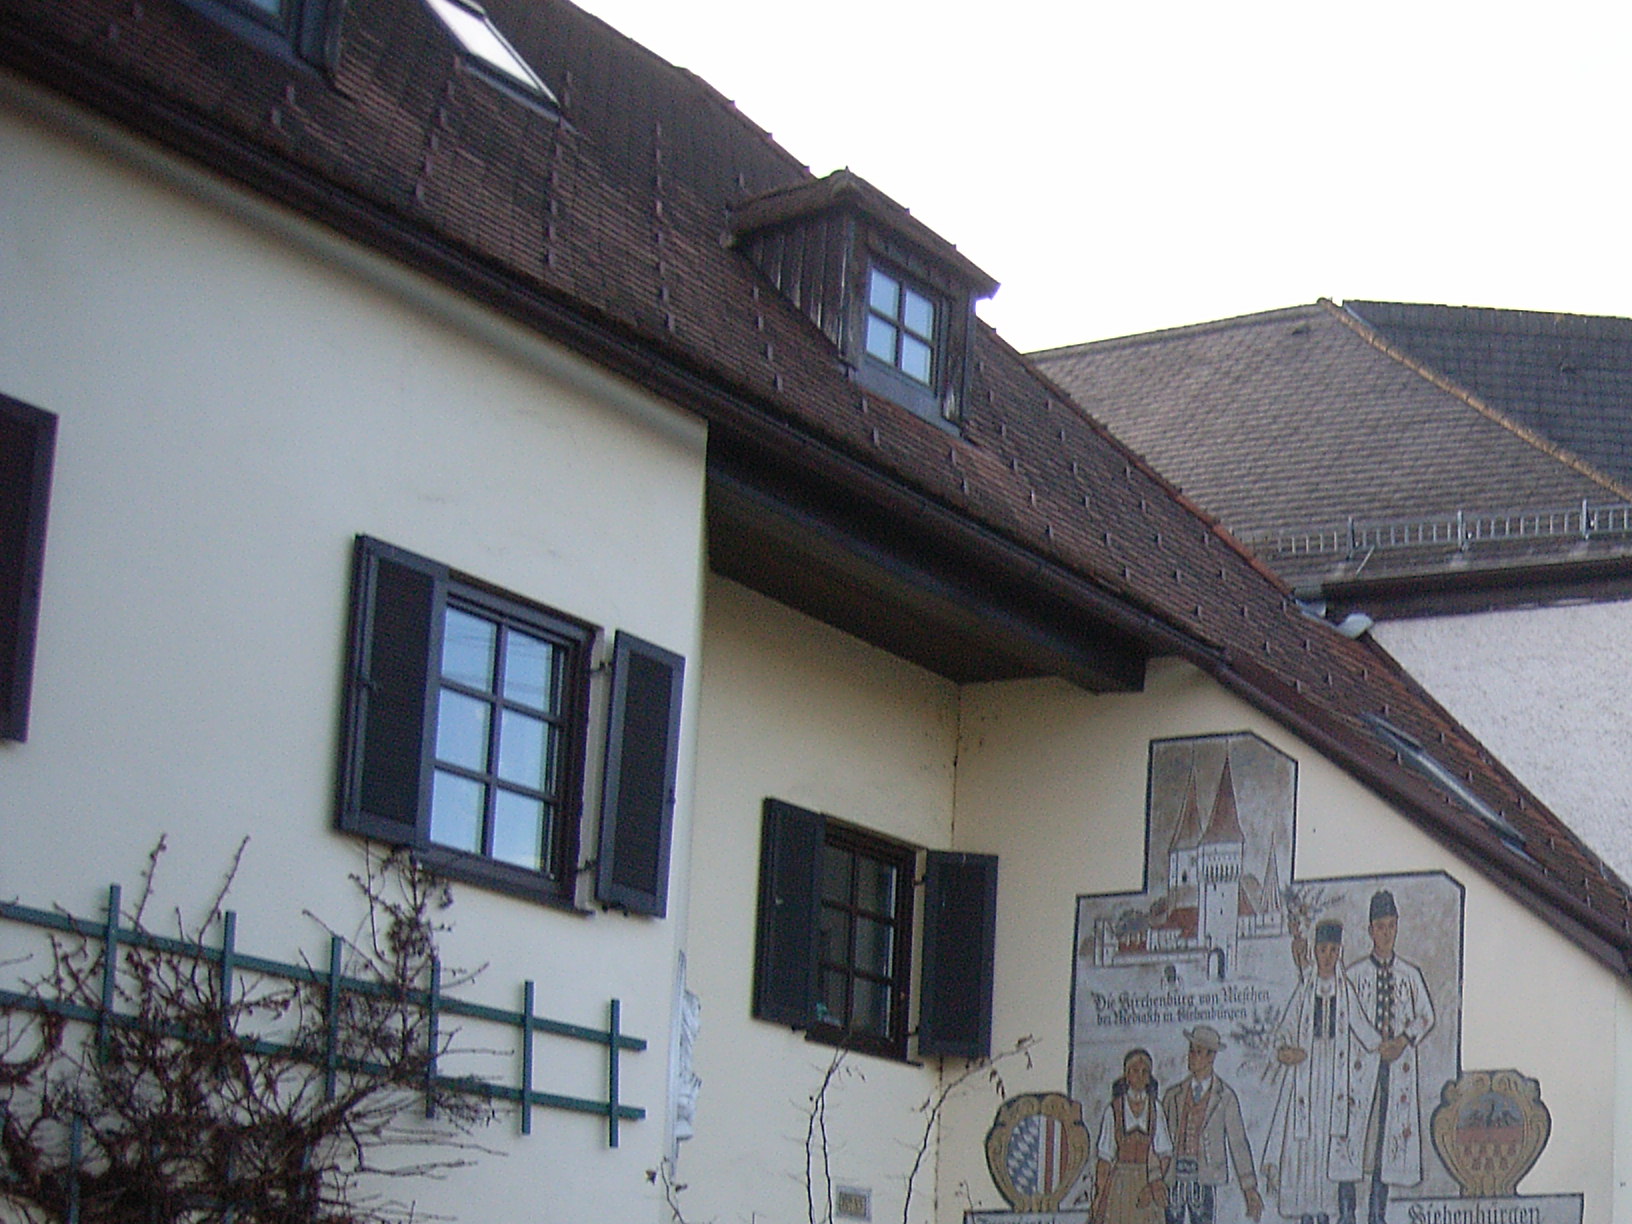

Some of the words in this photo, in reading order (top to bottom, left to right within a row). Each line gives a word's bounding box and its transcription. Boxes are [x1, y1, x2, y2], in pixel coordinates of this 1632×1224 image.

[1091, 990, 1114, 1012] Die
[1198, 993, 1219, 1006] von
[1097, 1012, 1112, 1027] bei
[1163, 1009, 1174, 1023] in
